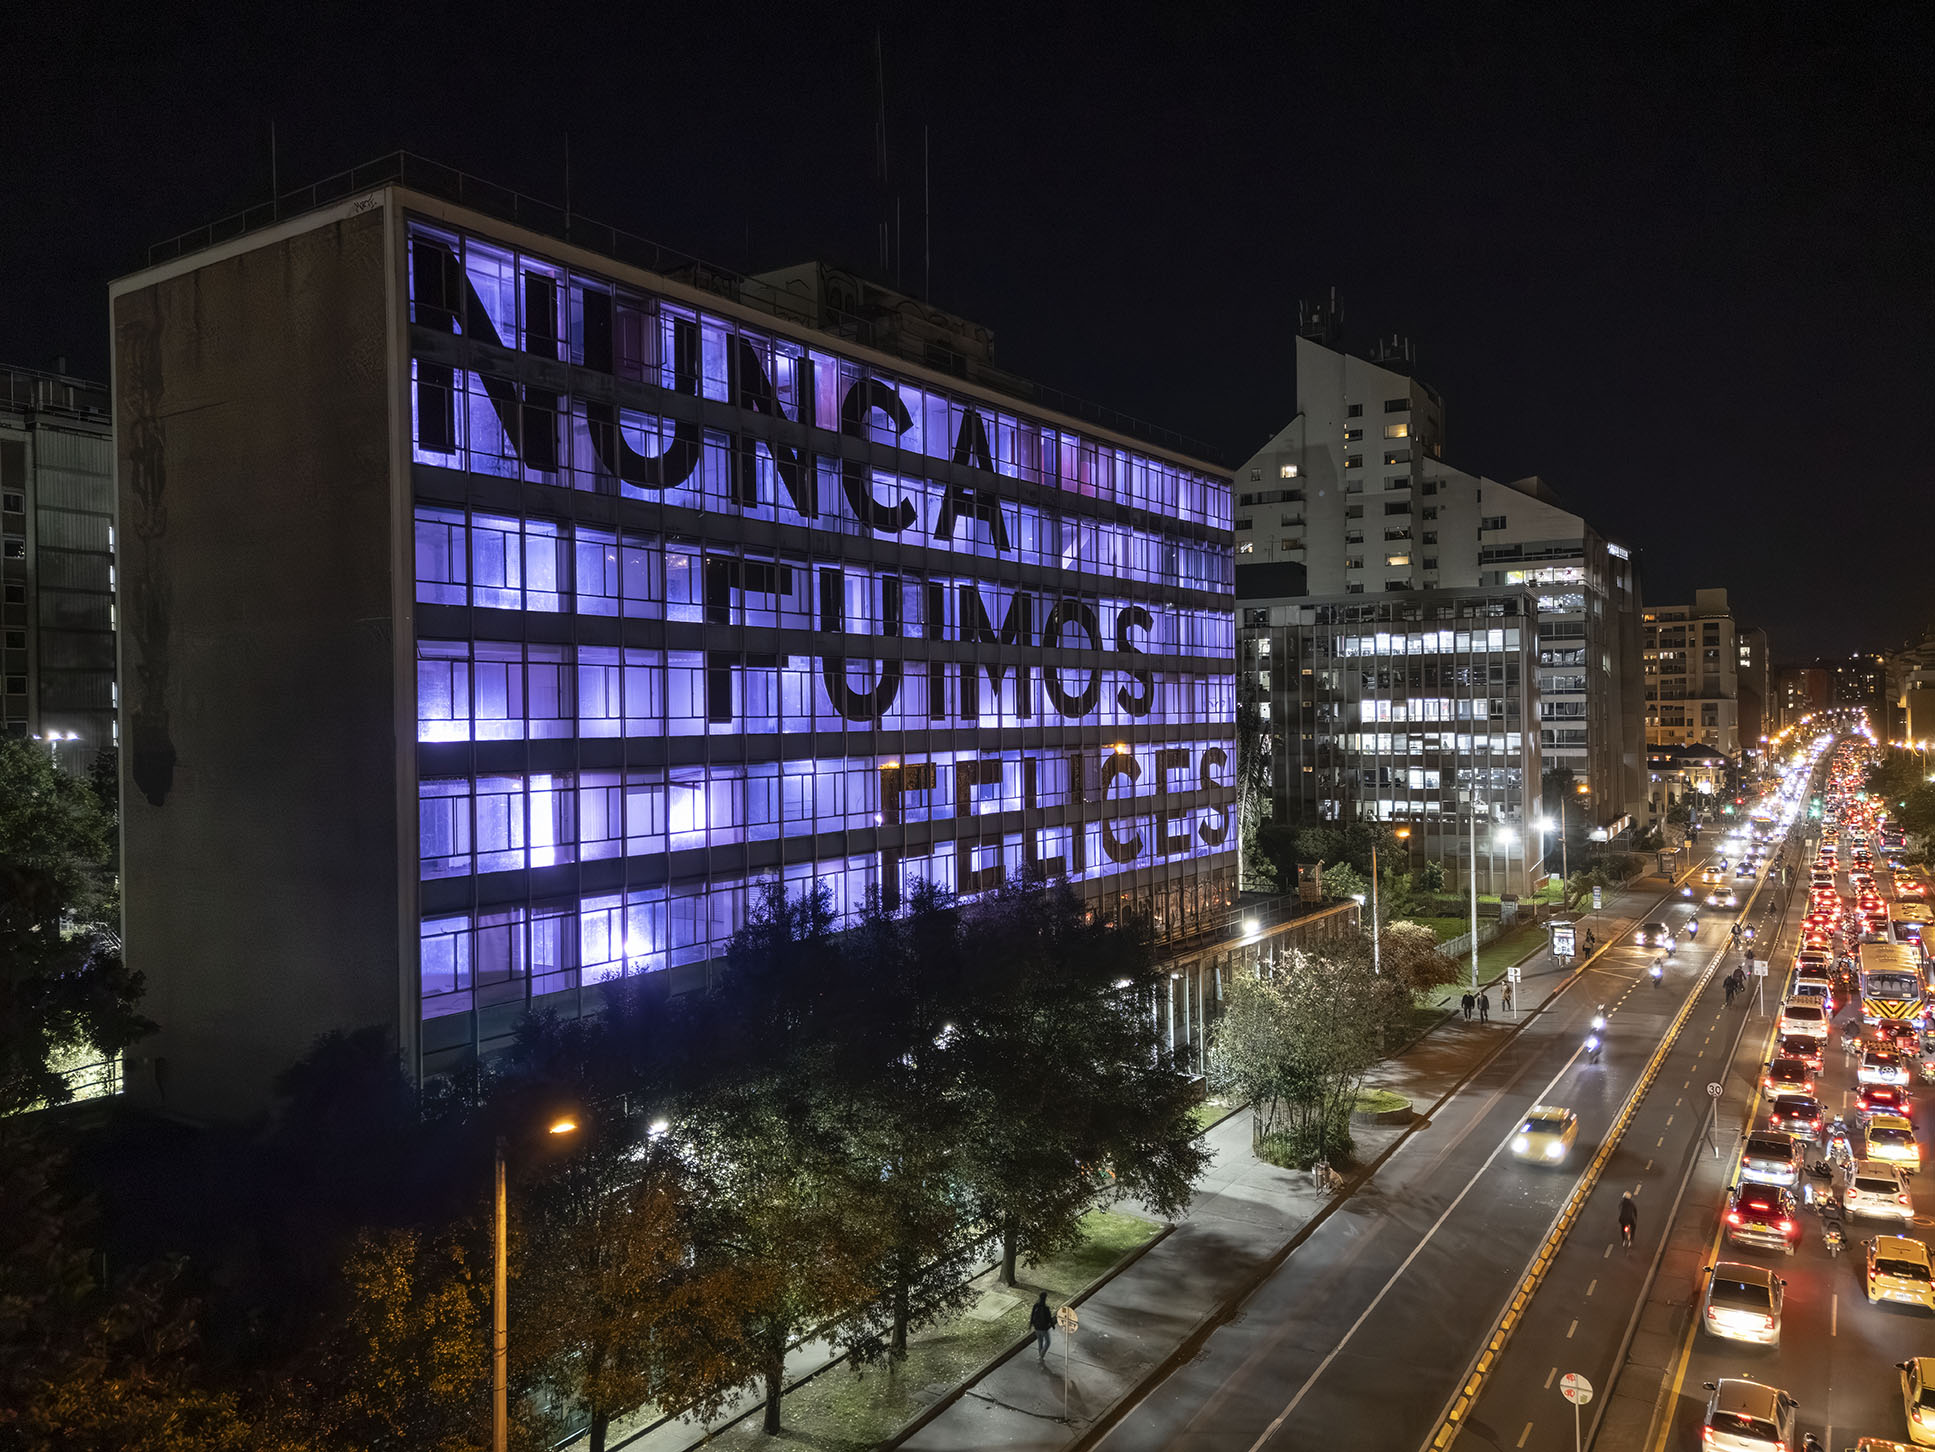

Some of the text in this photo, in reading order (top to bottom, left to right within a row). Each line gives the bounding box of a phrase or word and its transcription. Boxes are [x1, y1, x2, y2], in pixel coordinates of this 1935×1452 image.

[412, 233, 1011, 552] NUNCA
[705, 556, 1155, 724] FUIMOS
[880, 746, 1230, 912] FELICES
[1709, 1085, 1721, 1095] 30
